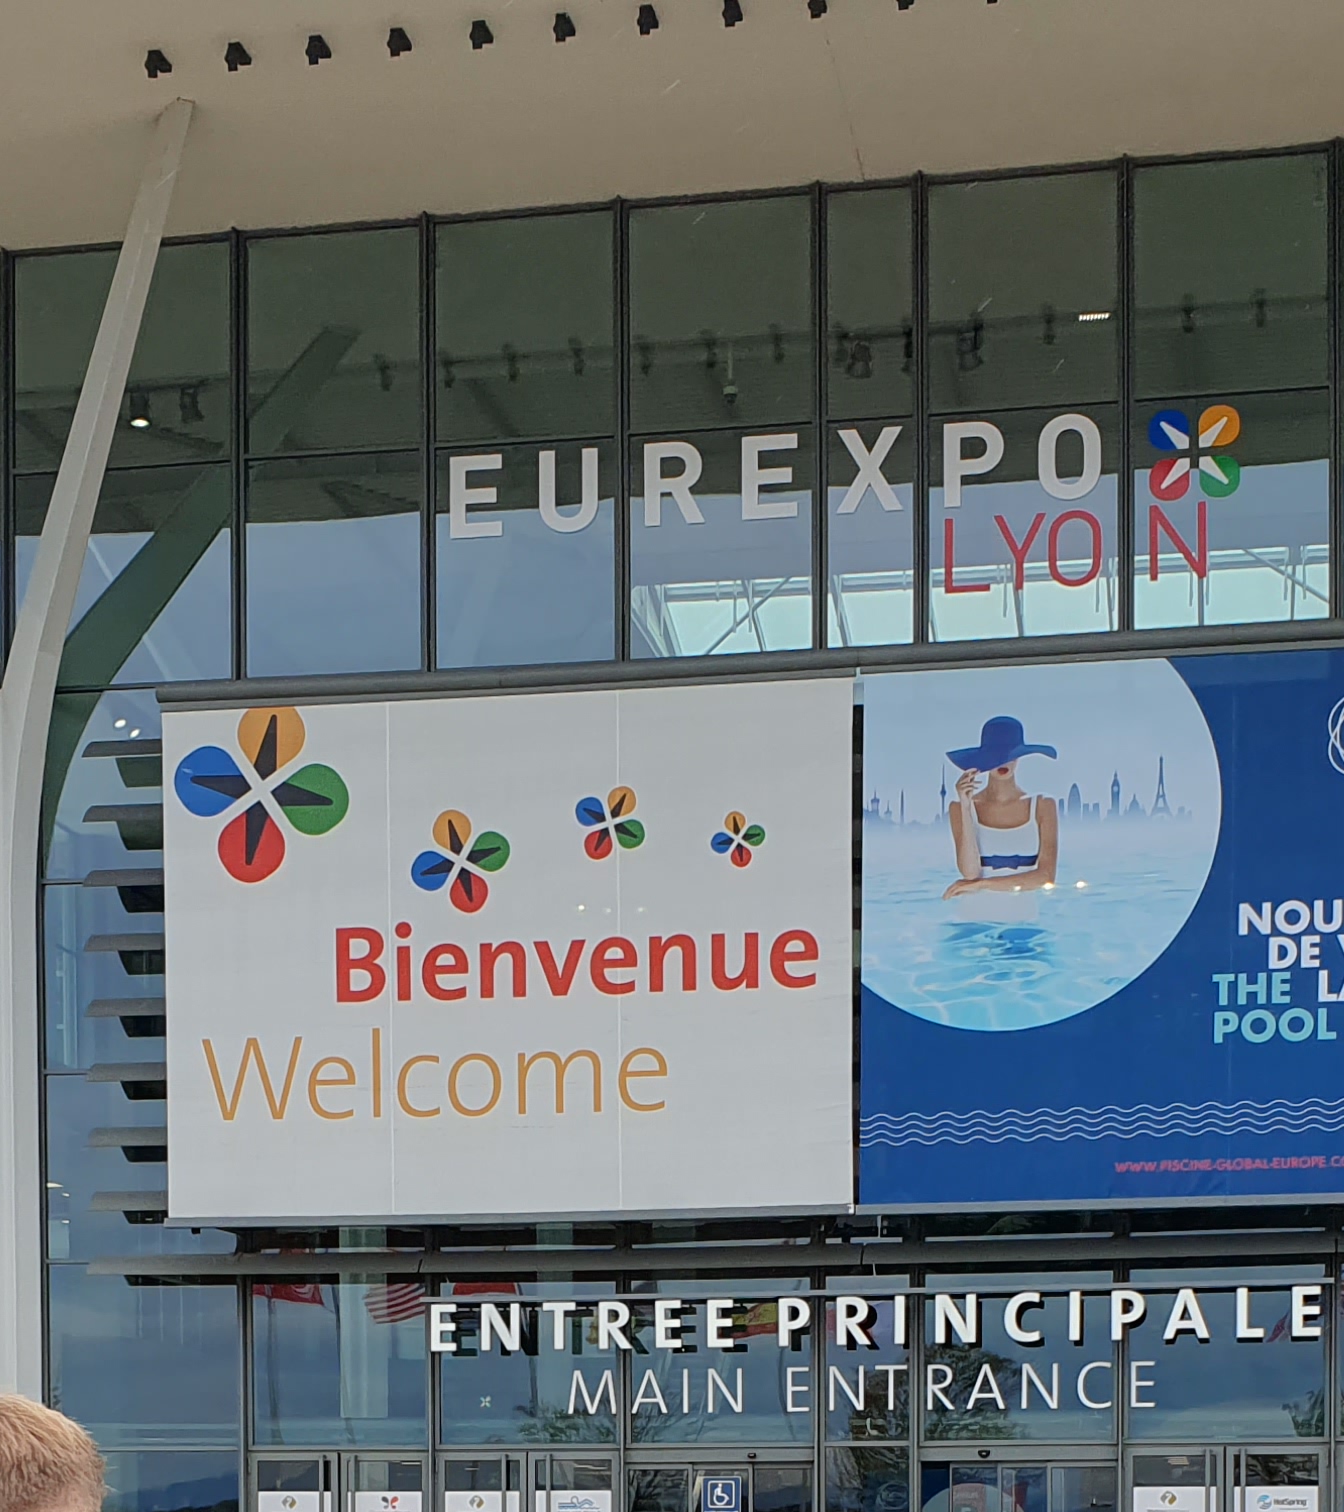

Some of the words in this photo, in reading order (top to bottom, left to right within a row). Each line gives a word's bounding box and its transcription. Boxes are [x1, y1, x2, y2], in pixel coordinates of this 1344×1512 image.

[449, 413, 1101, 539] EUREXPO
[943, 500, 1208, 594] LYON
[334, 921, 819, 1003] Bienvenue
[1268, 935, 1320, 969] DE
[1212, 972, 1291, 1006] THE
[1213, 1008, 1337, 1044] POOL
[202, 1027, 668, 1122] Welcome
[429, 1296, 736, 1354] ENTREE
[777, 1284, 1323, 1350] PRINCIPALE
[567, 1366, 744, 1416] MAIN
[785, 1360, 1157, 1414] ENTRANCE
